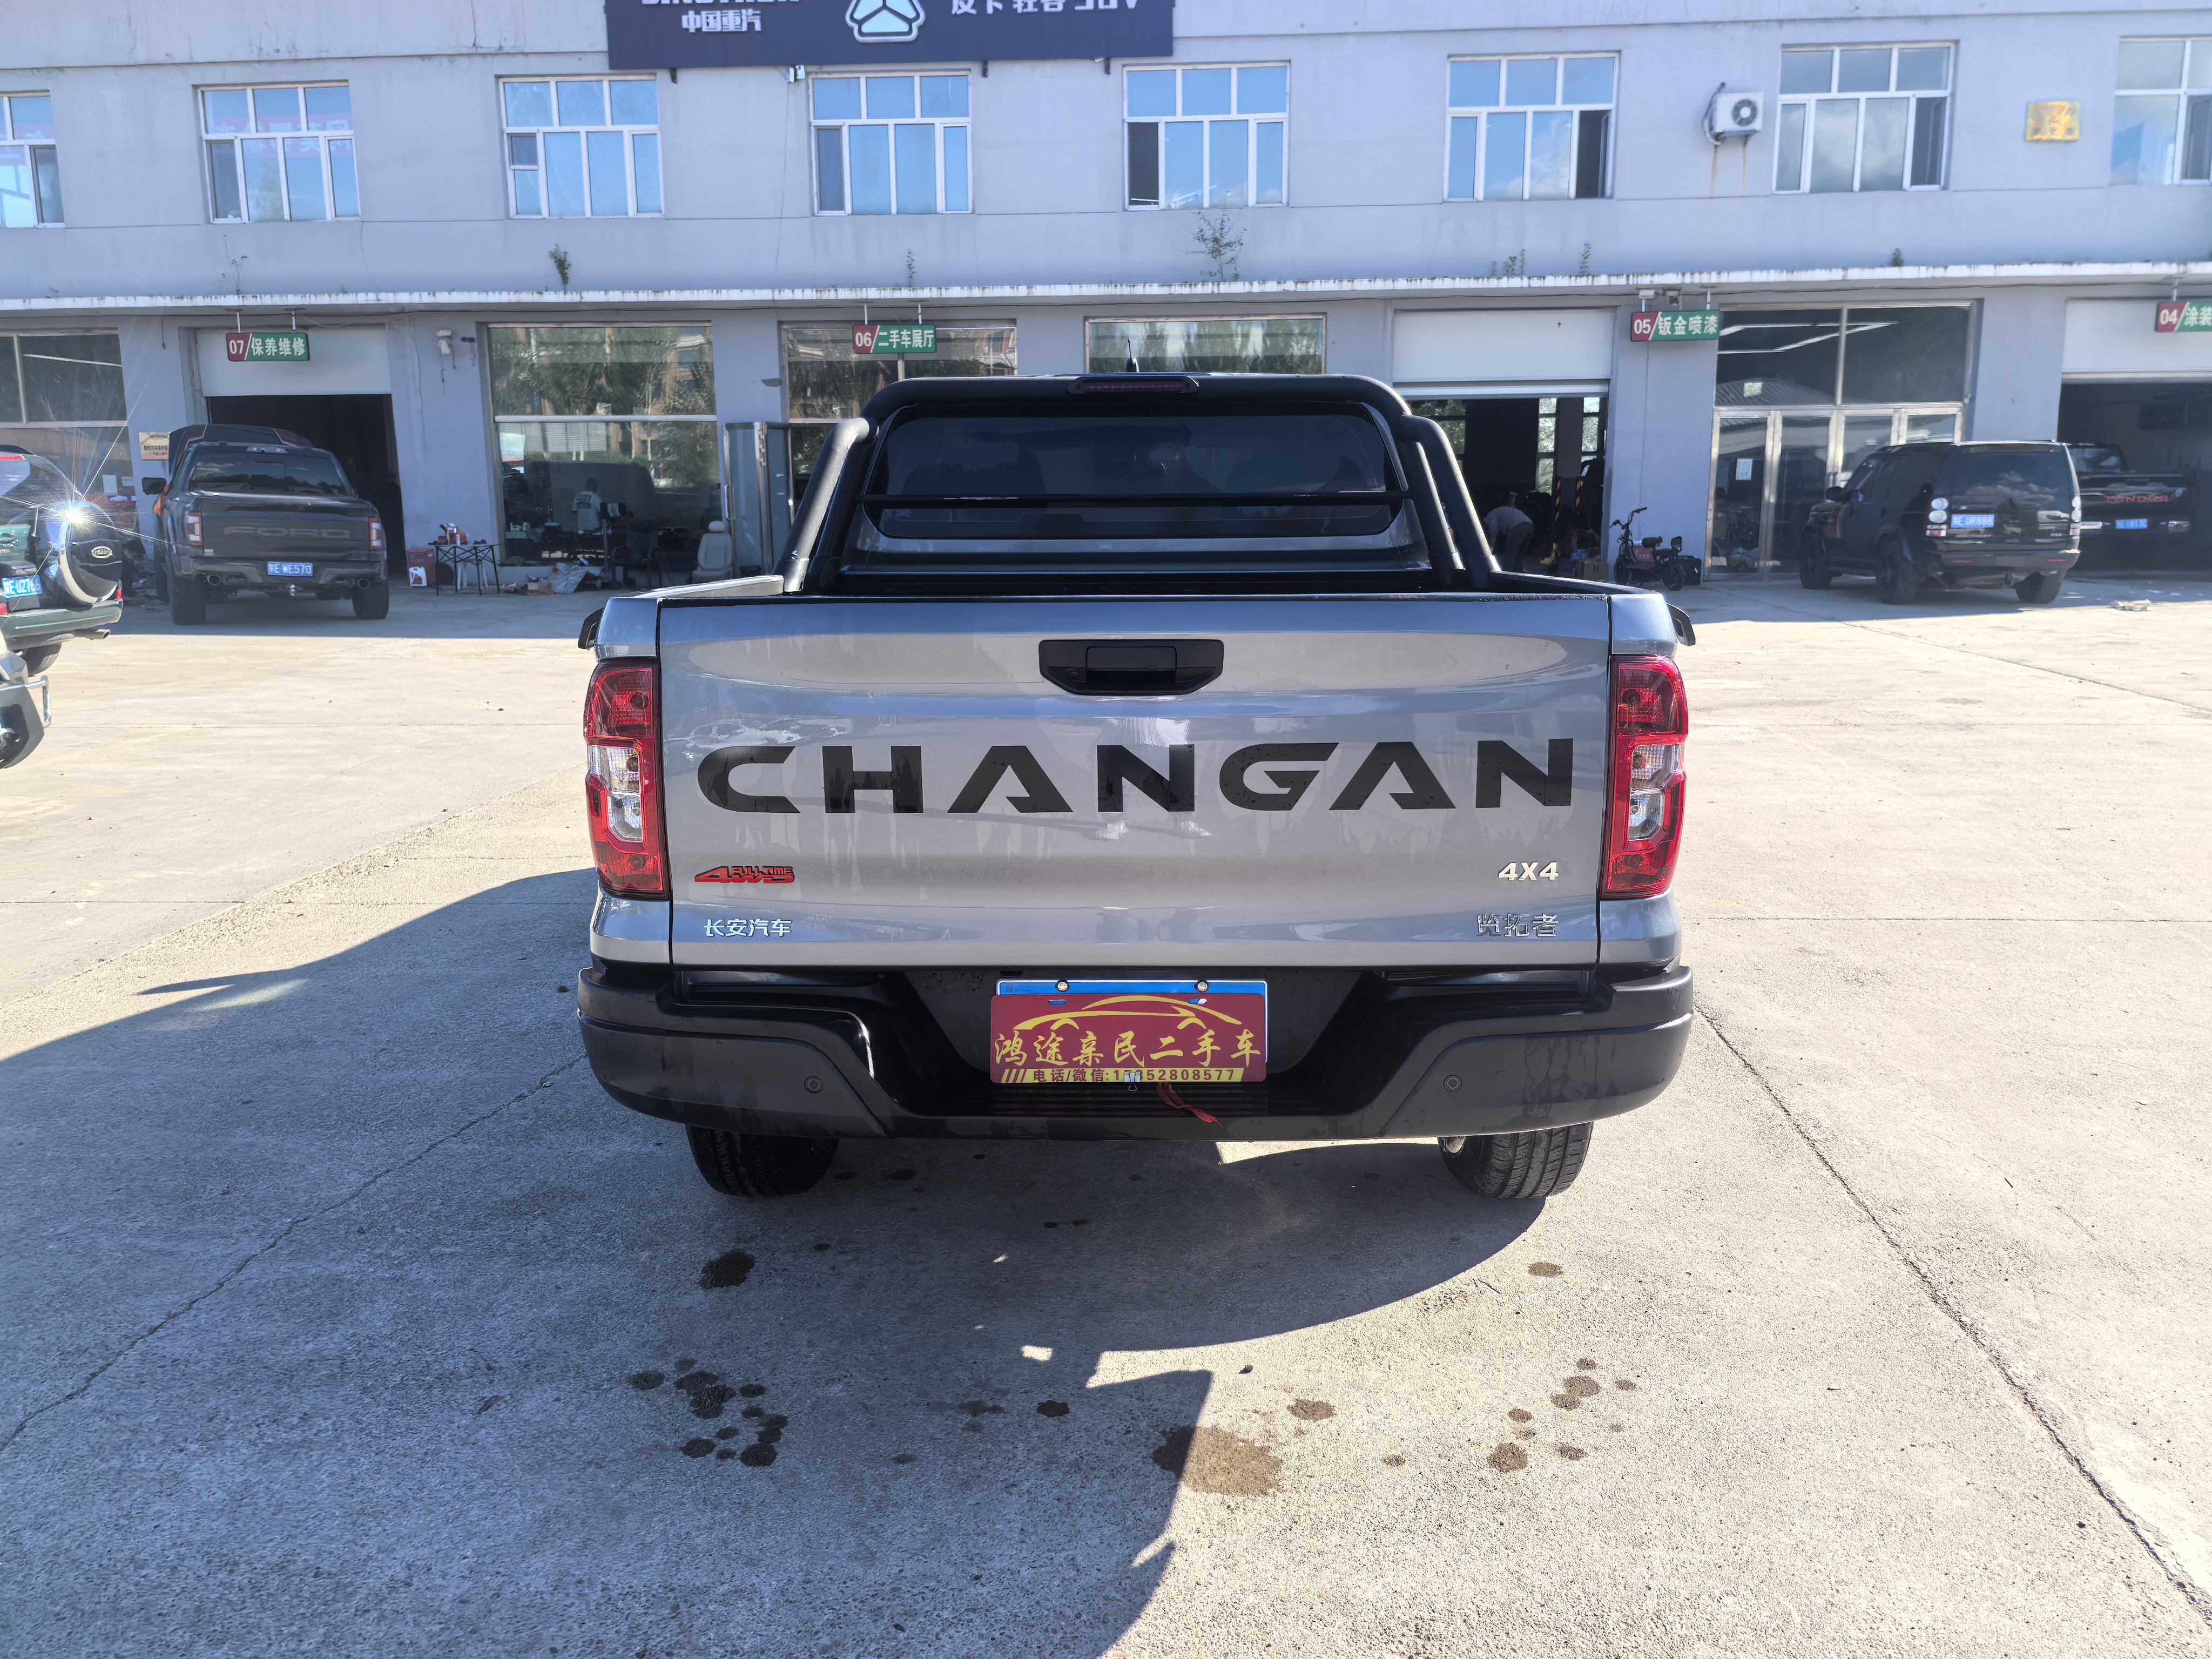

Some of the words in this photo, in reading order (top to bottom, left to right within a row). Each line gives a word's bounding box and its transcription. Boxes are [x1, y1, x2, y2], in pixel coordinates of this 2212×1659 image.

[682, 9, 761, 32] 中国重汽
[1634, 319, 1651, 334] 05
[1658, 315, 1718, 335] 钣金喷漆
[2160, 308, 2177, 325] 04
[229, 340, 244, 354] 07
[251, 338, 305, 356] 保养维修
[855, 332, 872, 347] 06
[878, 329, 934, 348] 二手车展厅
[224, 526, 350, 538] FORD
[698, 738, 1573, 813] CHANGAN
[694, 866, 795, 884] 4WD
[1498, 861, 1559, 881] 4X4
[704, 919, 791, 937] 长安汽车
[1476, 913, 1559, 937] 览拓者
[995, 1029, 1260, 1067] 鸿途亲民二手车
